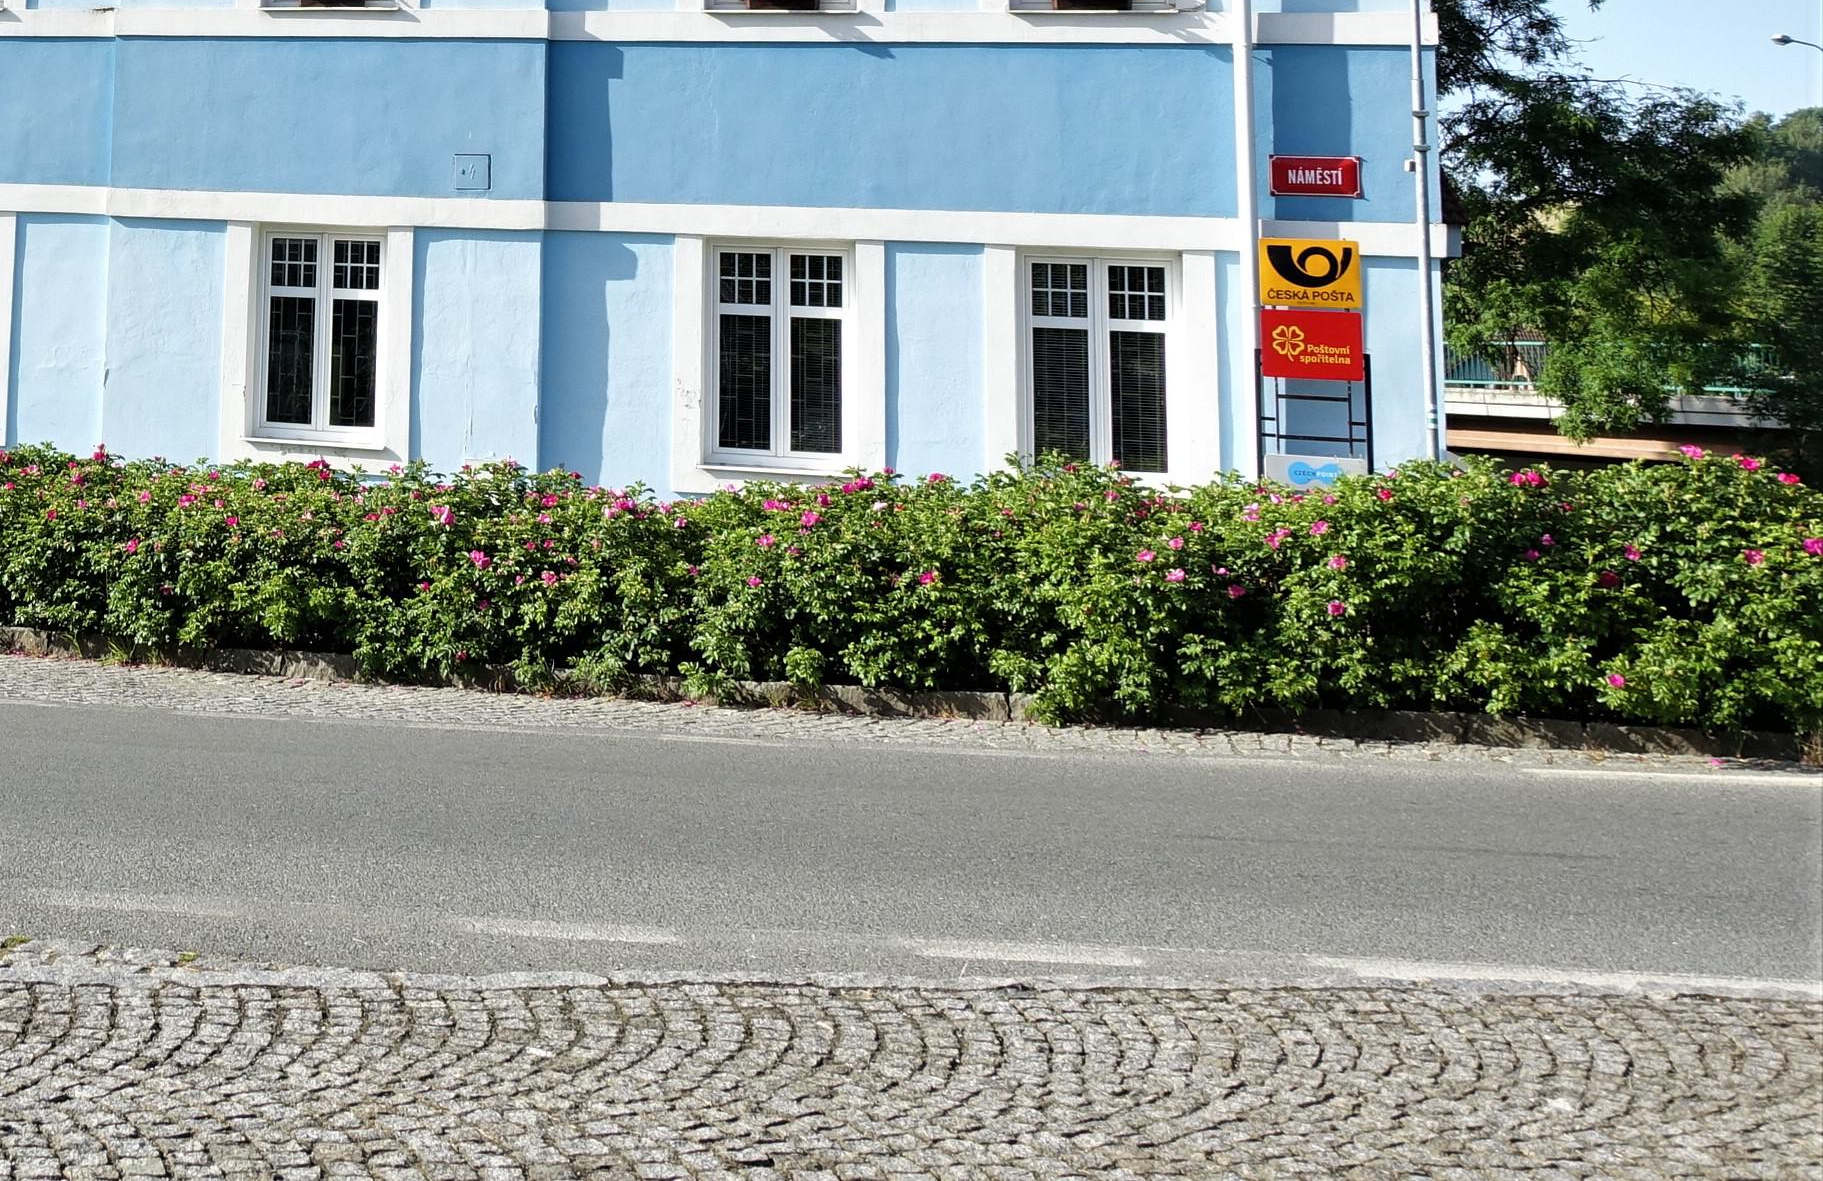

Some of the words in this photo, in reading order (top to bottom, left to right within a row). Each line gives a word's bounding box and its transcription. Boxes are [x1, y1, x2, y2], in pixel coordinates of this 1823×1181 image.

[1287, 166, 1343, 185] NÁMĚSTÍ
[1267, 288, 1309, 300] ČESKÁ
[1312, 290, 1355, 302] POŠTA
[1307, 344, 1350, 355] Poštovní
[1299, 354, 1351, 365] spořitelna
